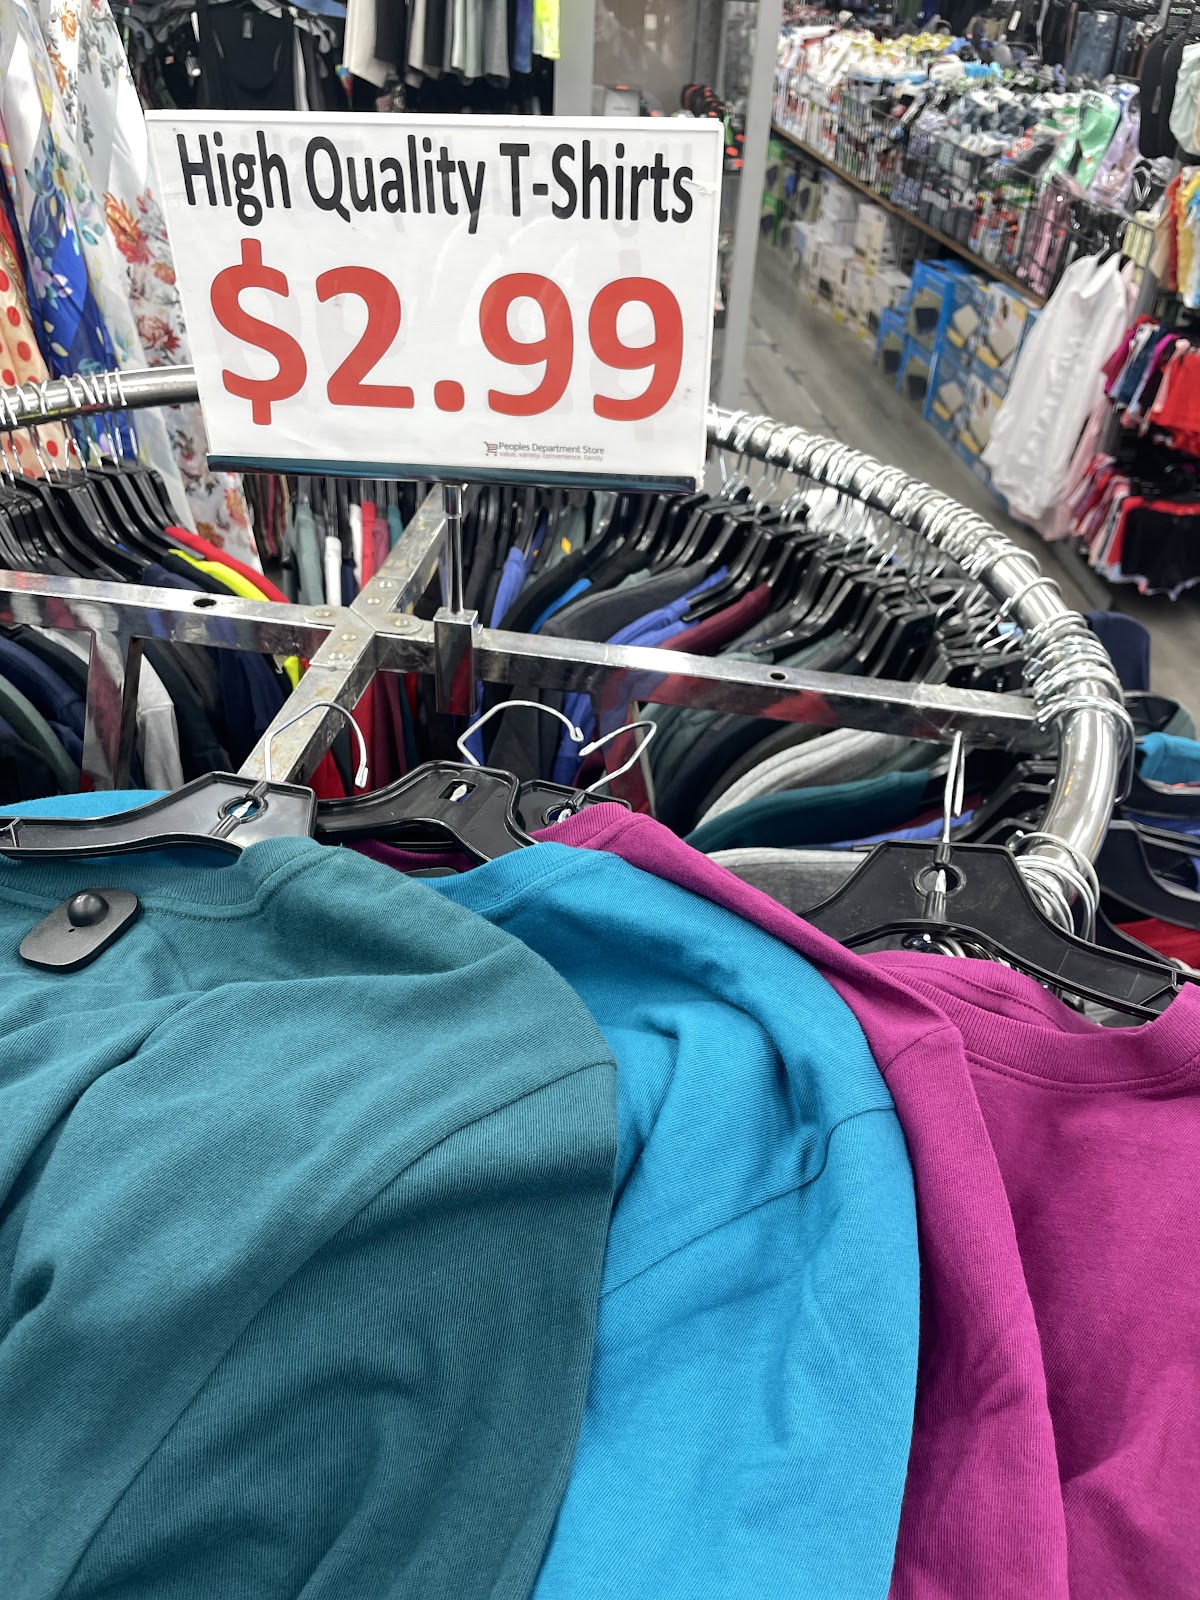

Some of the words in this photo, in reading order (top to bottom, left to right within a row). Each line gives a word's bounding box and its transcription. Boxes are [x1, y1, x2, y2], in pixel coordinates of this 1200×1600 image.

[176, 130, 292, 227] High
[305, 134, 486, 235] Quality
[499, 139, 693, 224] T-Shirts
[210, 238, 683, 425] $2.99
[498, 442, 530, 452] Peoples
[532, 443, 580, 454] Department
[582, 446, 605, 455] Store
